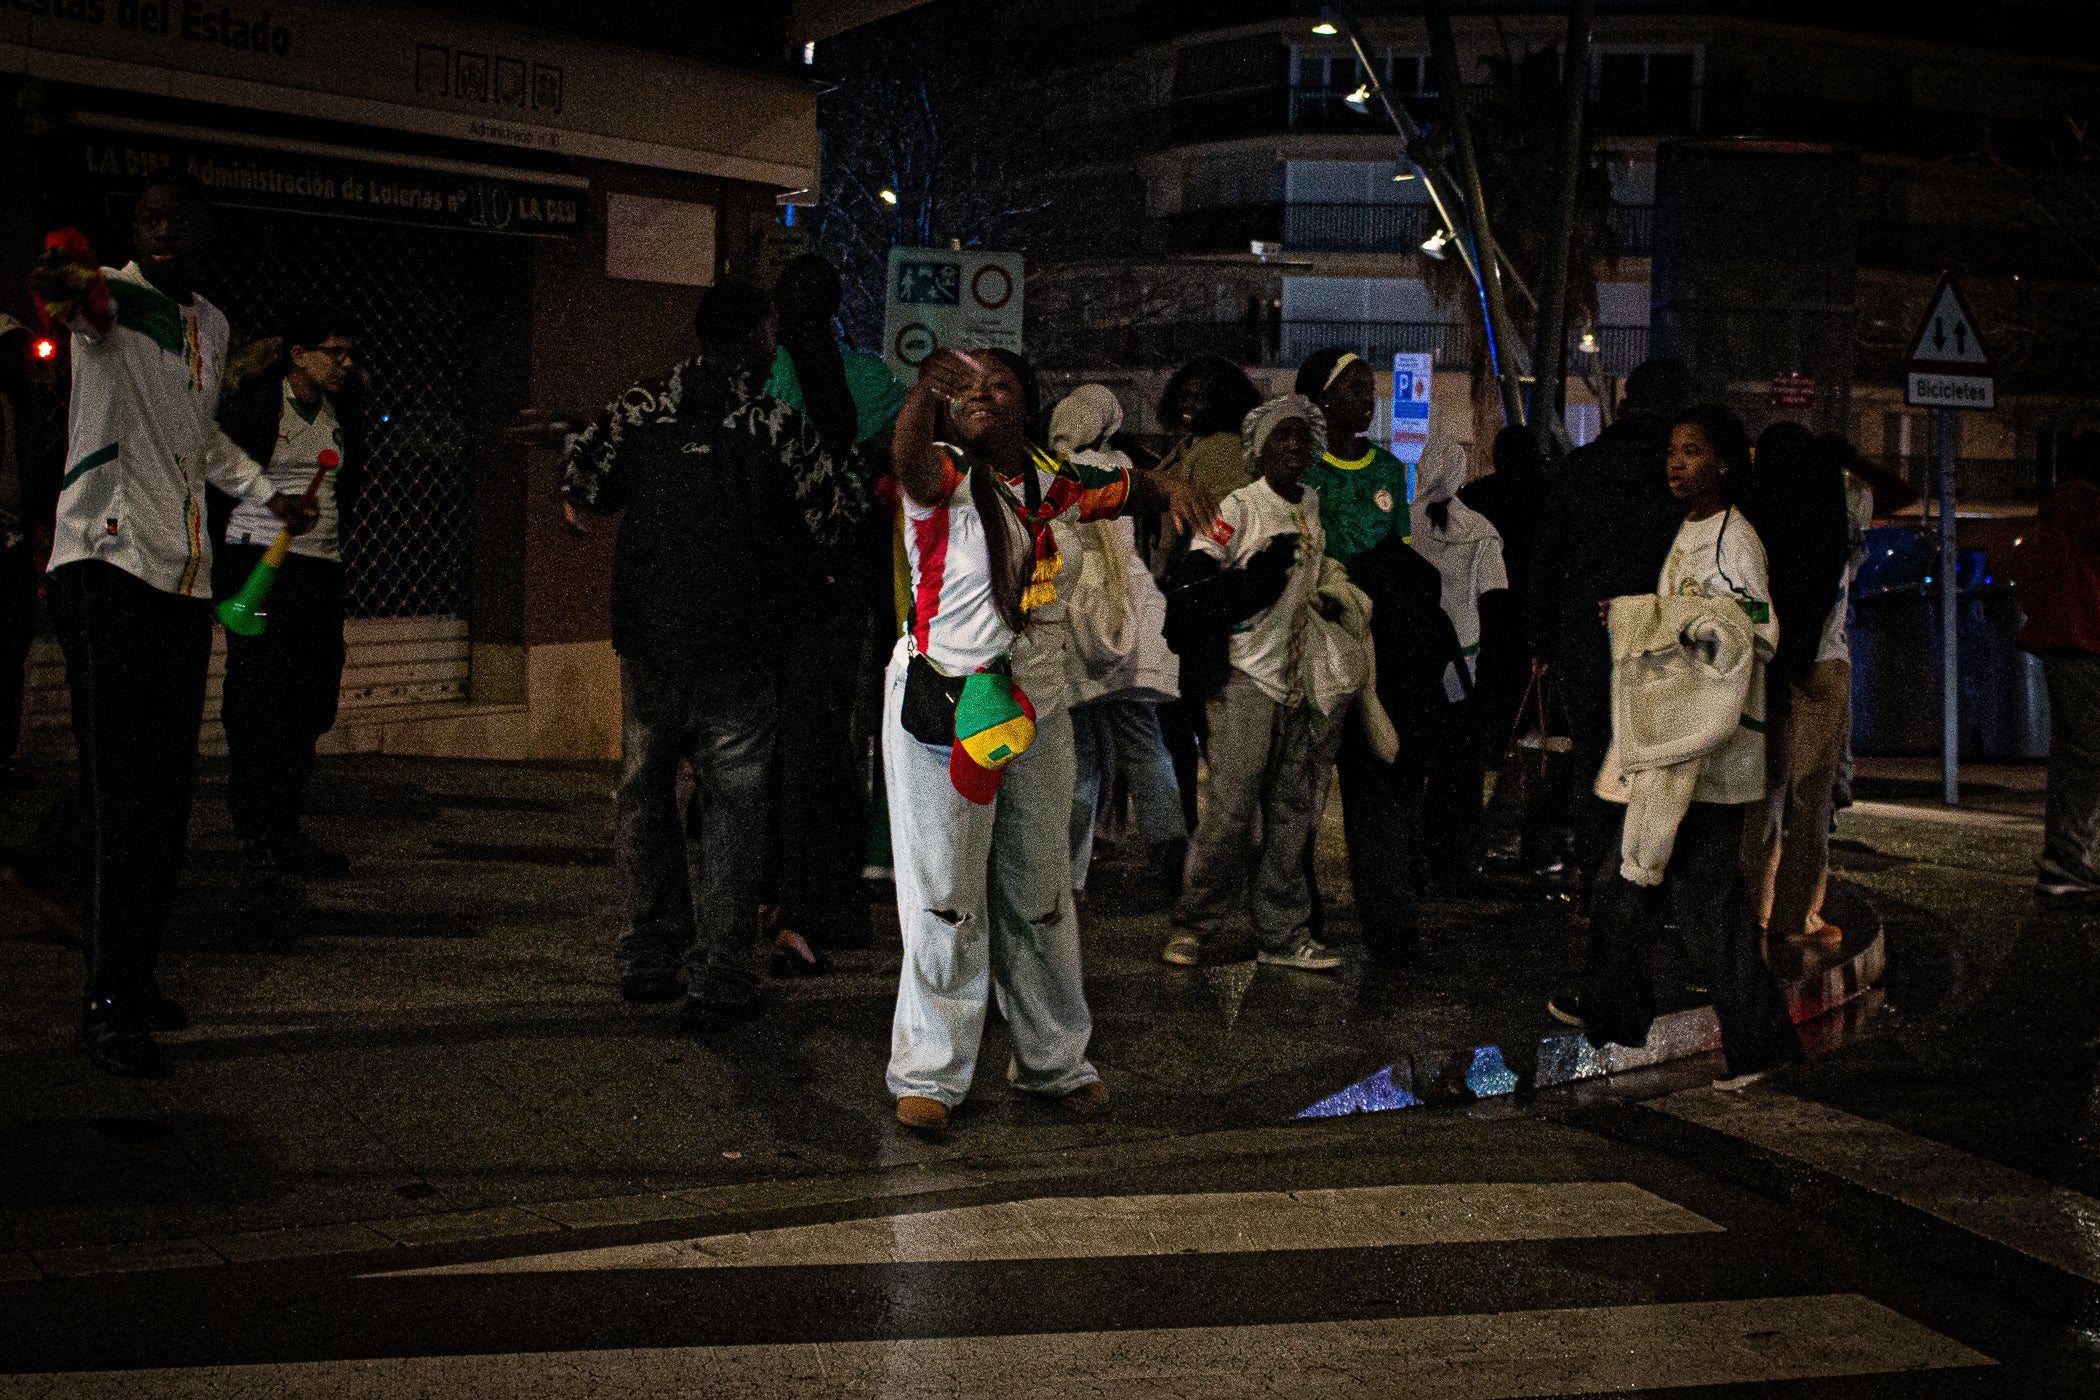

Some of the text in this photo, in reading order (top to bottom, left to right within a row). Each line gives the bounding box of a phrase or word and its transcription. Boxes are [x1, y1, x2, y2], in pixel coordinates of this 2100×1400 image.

[118, 0, 168, 37] del
[182, 0, 290, 56] Estado
[85, 143, 120, 176] LA
[187, 154, 335, 199] Administración
[341, 175, 364, 203] de
[467, 181, 513, 231] 10
[518, 195, 543, 221] LA
[1917, 378, 1986, 401] Bicicletes
